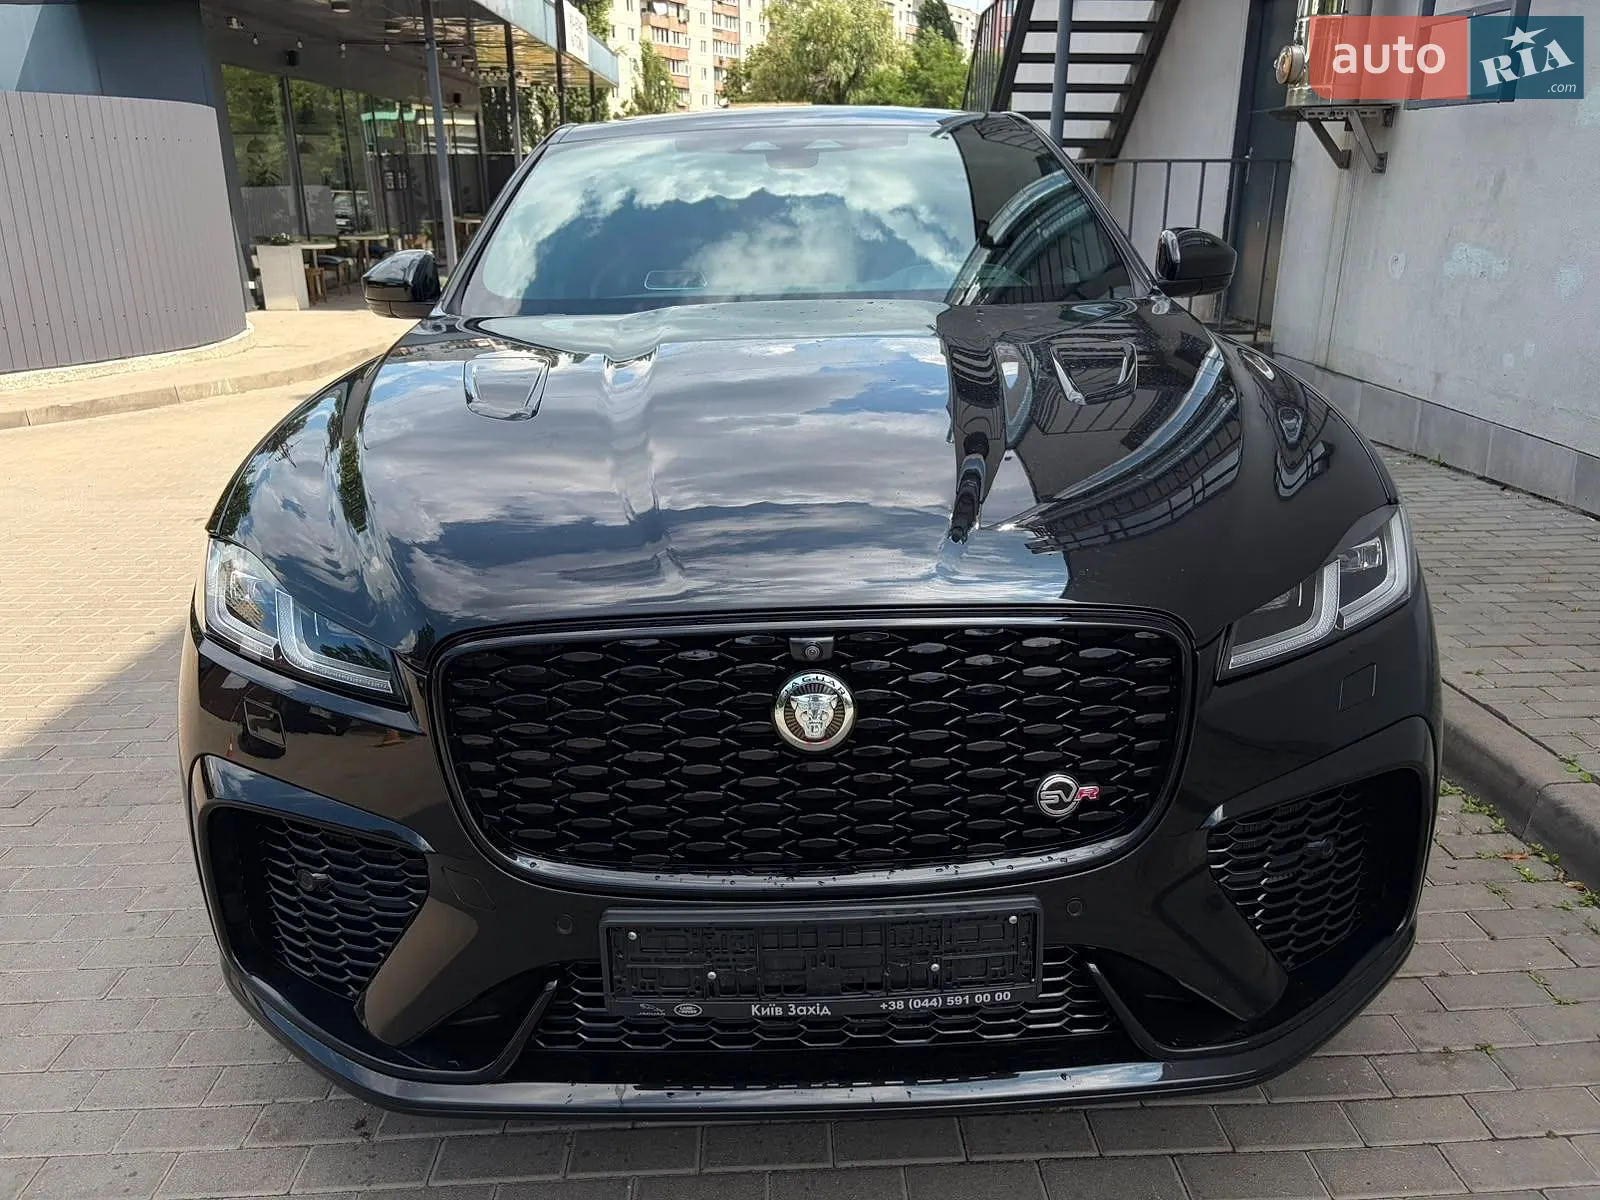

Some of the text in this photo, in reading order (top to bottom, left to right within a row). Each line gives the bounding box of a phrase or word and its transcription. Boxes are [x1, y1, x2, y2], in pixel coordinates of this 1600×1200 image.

[880, 991, 1011, 1010] +38 (044) 591 00 00
[751, 1003, 832, 1016] Київ Захід
